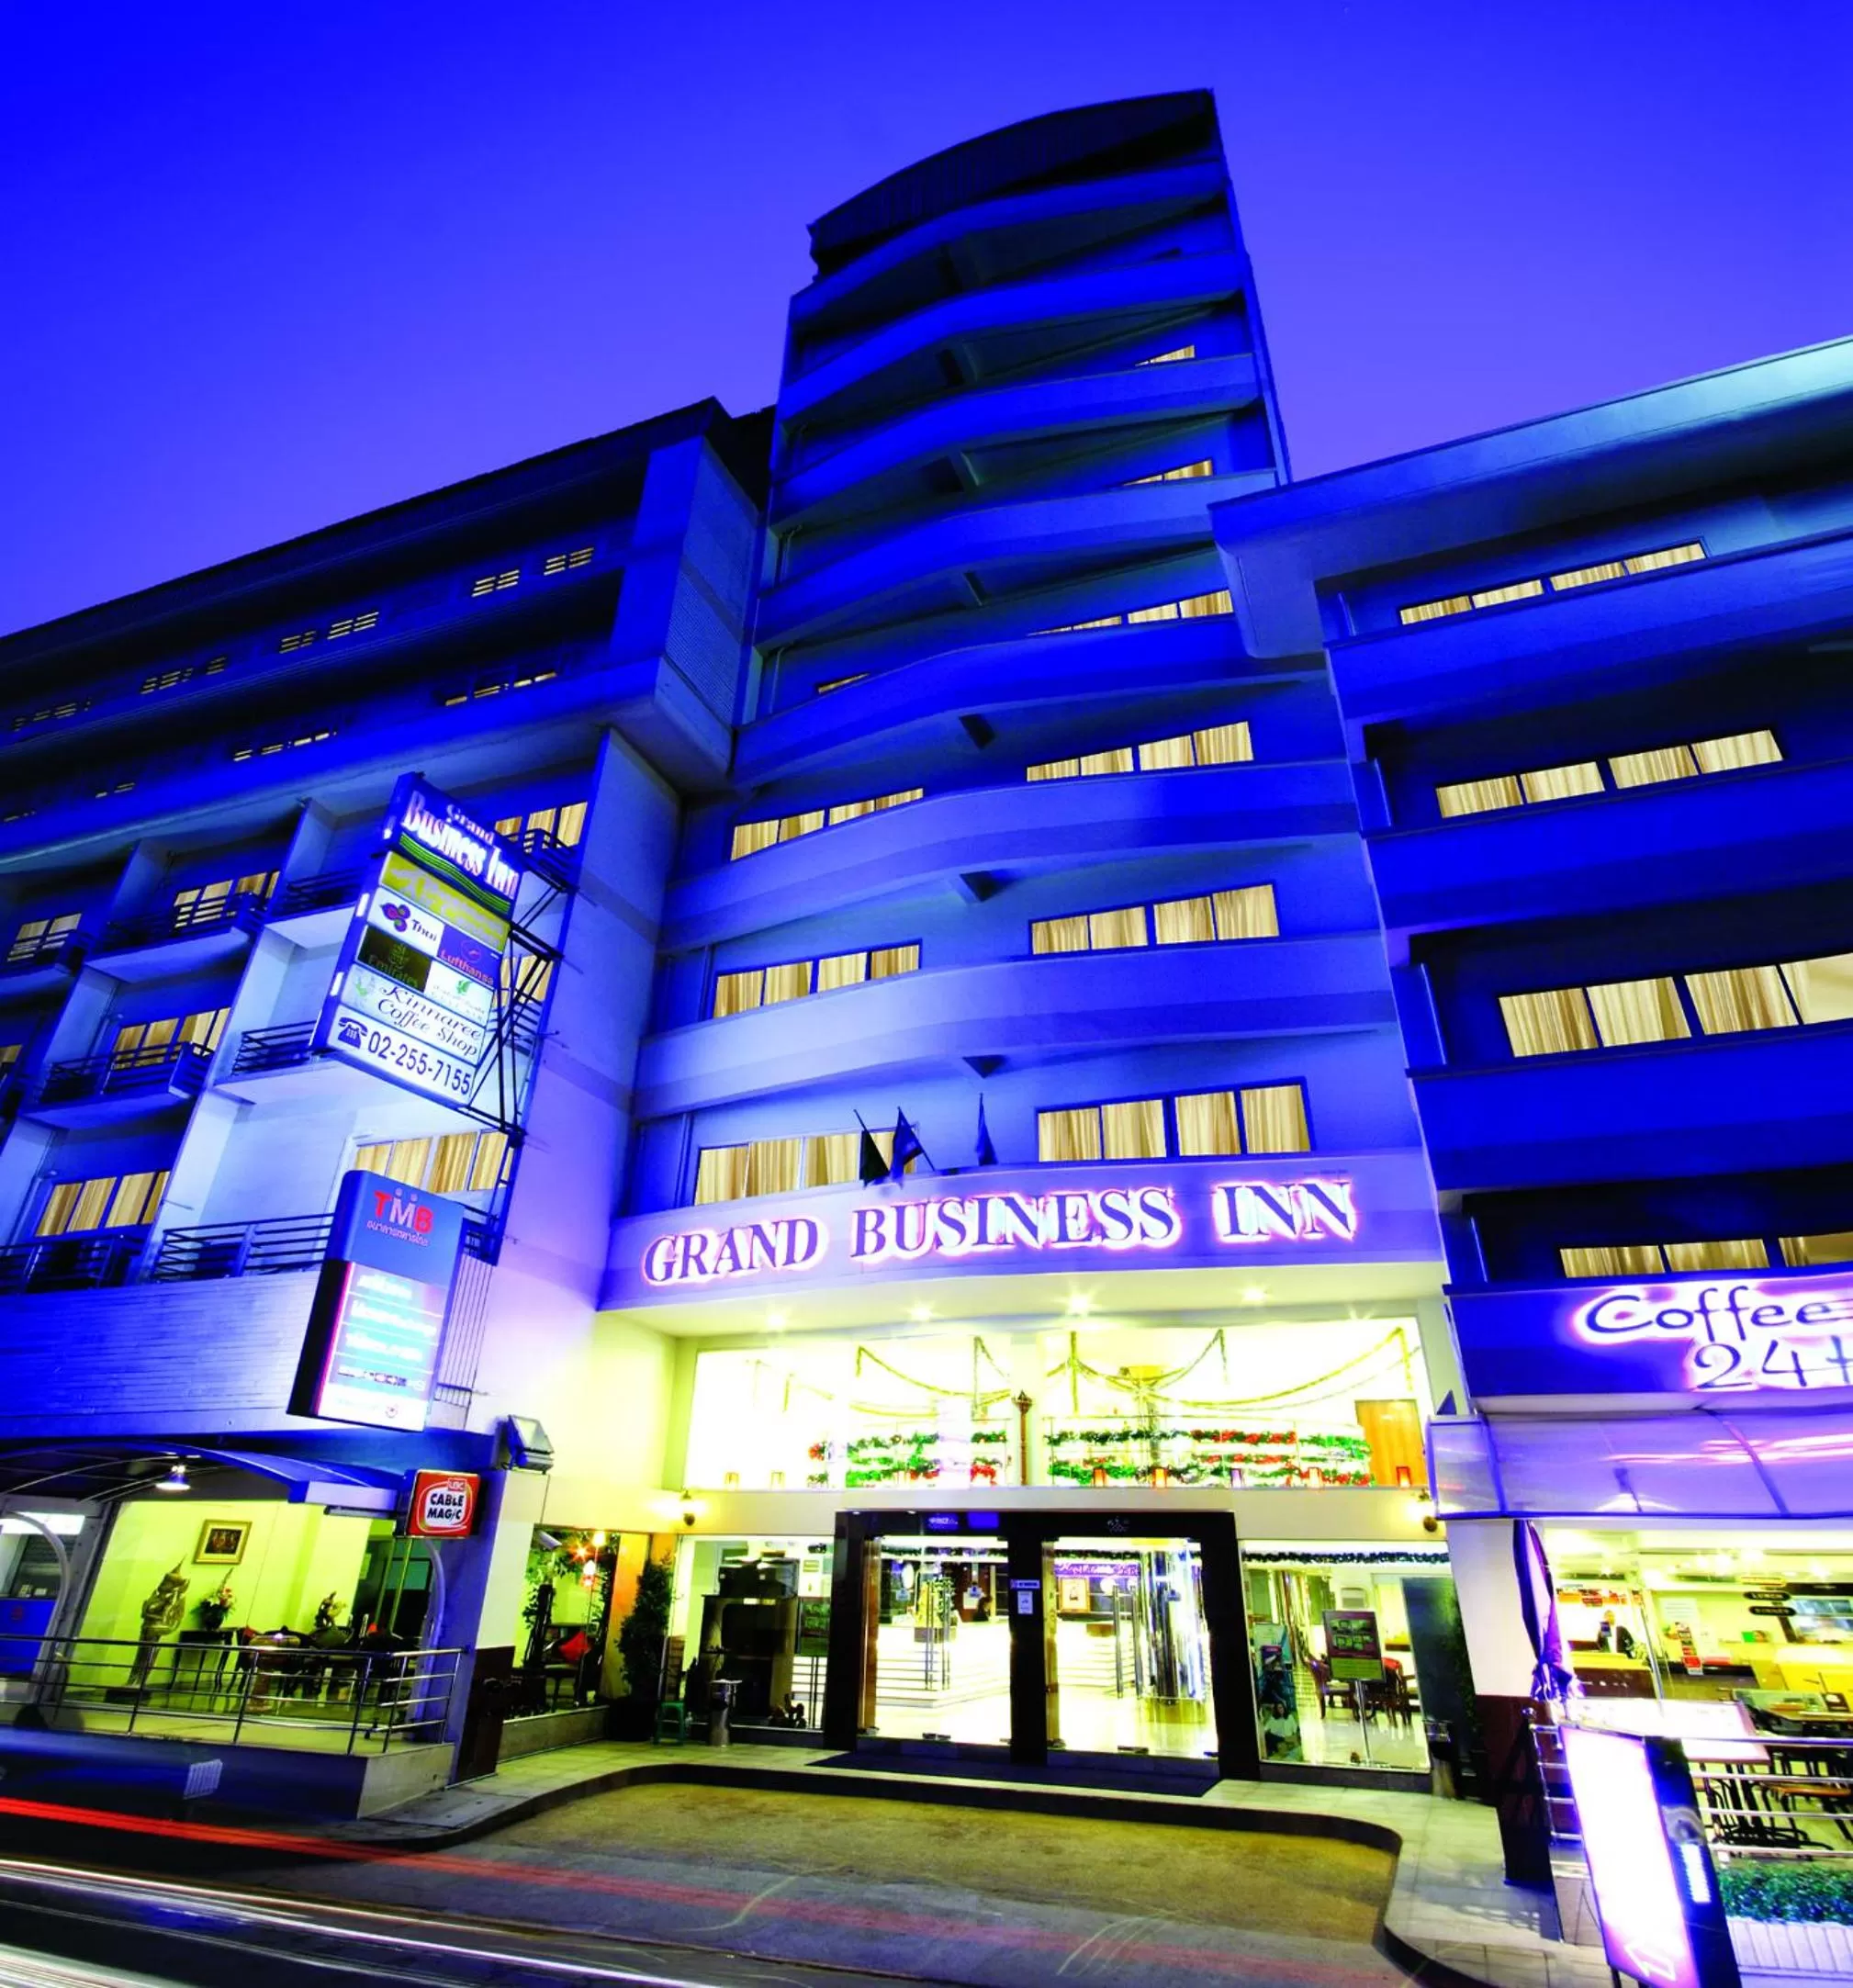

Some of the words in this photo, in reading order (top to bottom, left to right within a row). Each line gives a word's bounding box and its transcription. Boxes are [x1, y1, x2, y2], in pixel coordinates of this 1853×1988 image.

[399, 790, 488, 877] Business
[484, 844, 520, 900] Inn
[445, 803, 495, 847] Grand
[411, 918, 438, 942] Thai
[439, 949, 495, 985] Lufthansa
[377, 998, 431, 1030] Coffee
[436, 1027, 478, 1057] Shop
[379, 985, 482, 1040] Kinnaree
[367, 1030, 472, 1095] 02-255-7155
[373, 1188, 435, 1235] TMB
[643, 1217, 820, 1284] GRAND
[849, 1187, 1175, 1259] BUSINESS
[1216, 1181, 1355, 1239] INN
[1585, 1285, 1853, 1342] Coffee
[426, 1507, 463, 1522] MAGIC
[429, 1493, 466, 1507] CABLE
